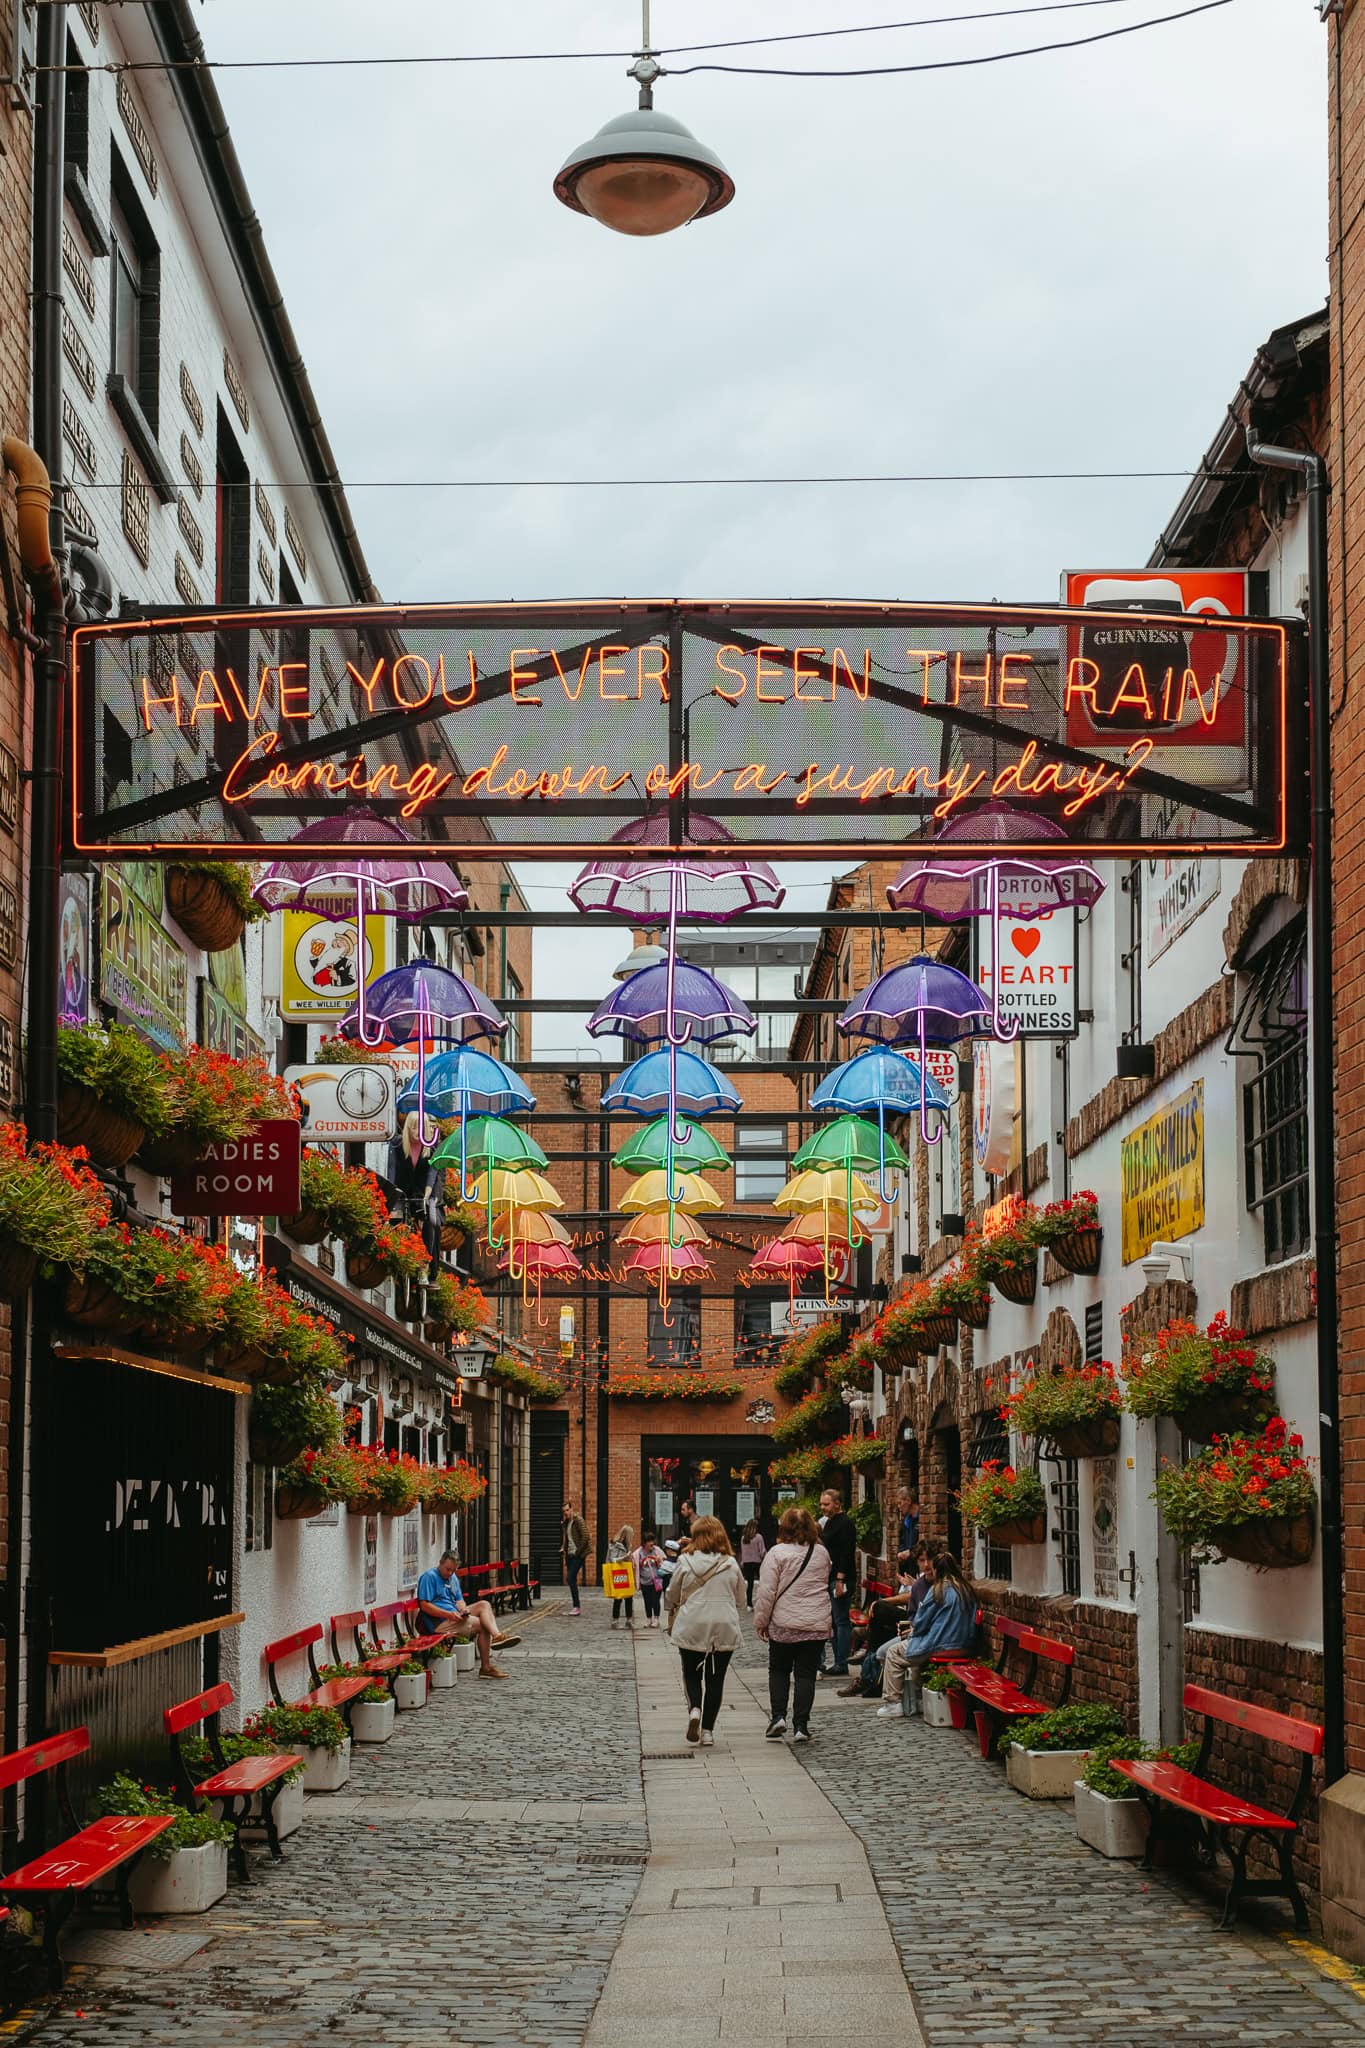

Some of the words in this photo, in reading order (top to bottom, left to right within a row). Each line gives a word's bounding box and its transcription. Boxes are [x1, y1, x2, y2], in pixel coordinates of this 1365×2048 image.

[1094, 628, 1179, 646] GUINNESS
[142, 663, 313, 732] HAVE
[346, 649, 477, 713] YOU
[509, 645, 671, 705] EVER
[715, 644, 871, 704] SEEN
[906, 648, 1032, 709] THE
[1065, 657, 1222, 726] RAIN
[223, 731, 453, 817] Coming
[463, 744, 629, 799] down
[645, 762, 724, 799] on
[734, 762, 787, 795] a
[795, 760, 988, 819] sunny
[991, 737, 1154, 816] day?
[980, 965, 1073, 984] HEART
[997, 993, 1057, 1006] BOTTLED
[314, 1119, 386, 1132] GUINNESS
[196, 1143, 280, 1162] ADIES
[1124, 1139, 1139, 1203] OLD
[1142, 1094, 1199, 1188] BUSHMILLS
[196, 1175, 273, 1193] ROOM
[1137, 1178, 1181, 1241] WHISKEY
